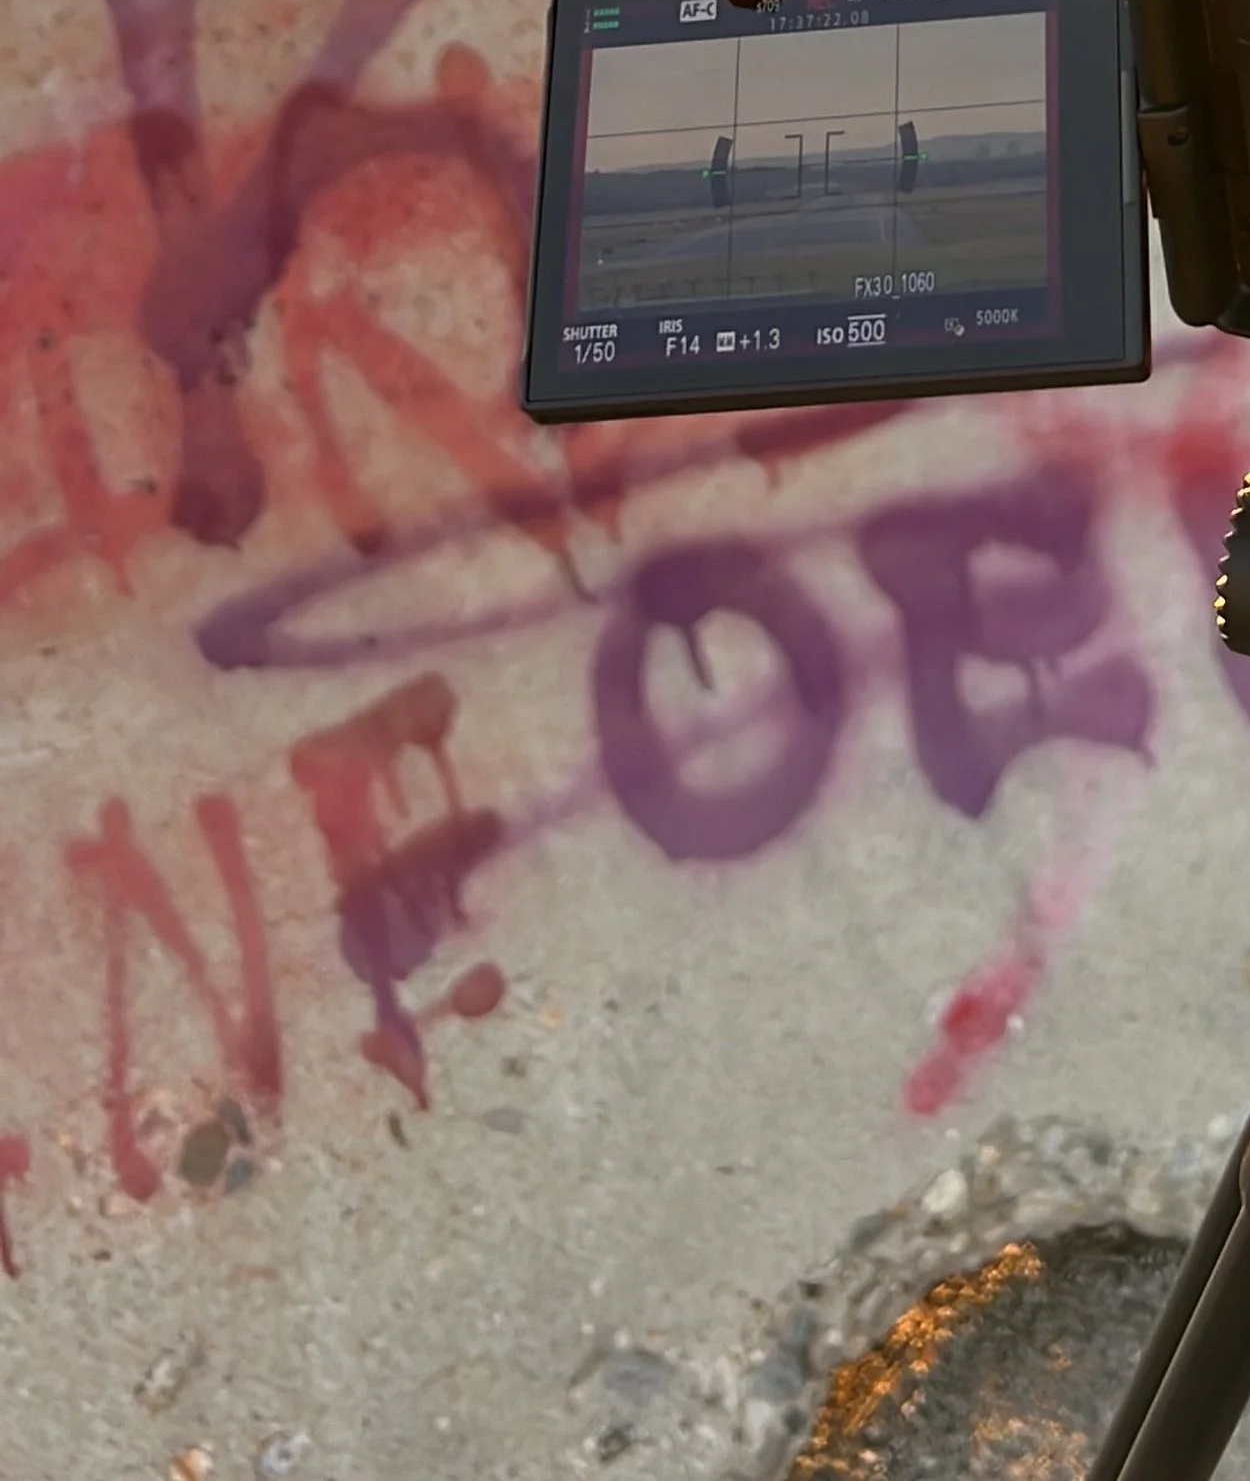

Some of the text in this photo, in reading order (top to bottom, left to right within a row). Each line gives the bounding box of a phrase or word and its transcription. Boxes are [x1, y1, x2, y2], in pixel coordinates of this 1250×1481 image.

[682, 3, 716, 19] AF-C
[854, 271, 935, 299] FX30_1060
[975, 308, 1019, 326] 5000K
[562, 324, 618, 342] SHUTTER
[659, 319, 683, 334] IRIS
[816, 317, 886, 345] ISO 500
[573, 342, 616, 365] 1/50
